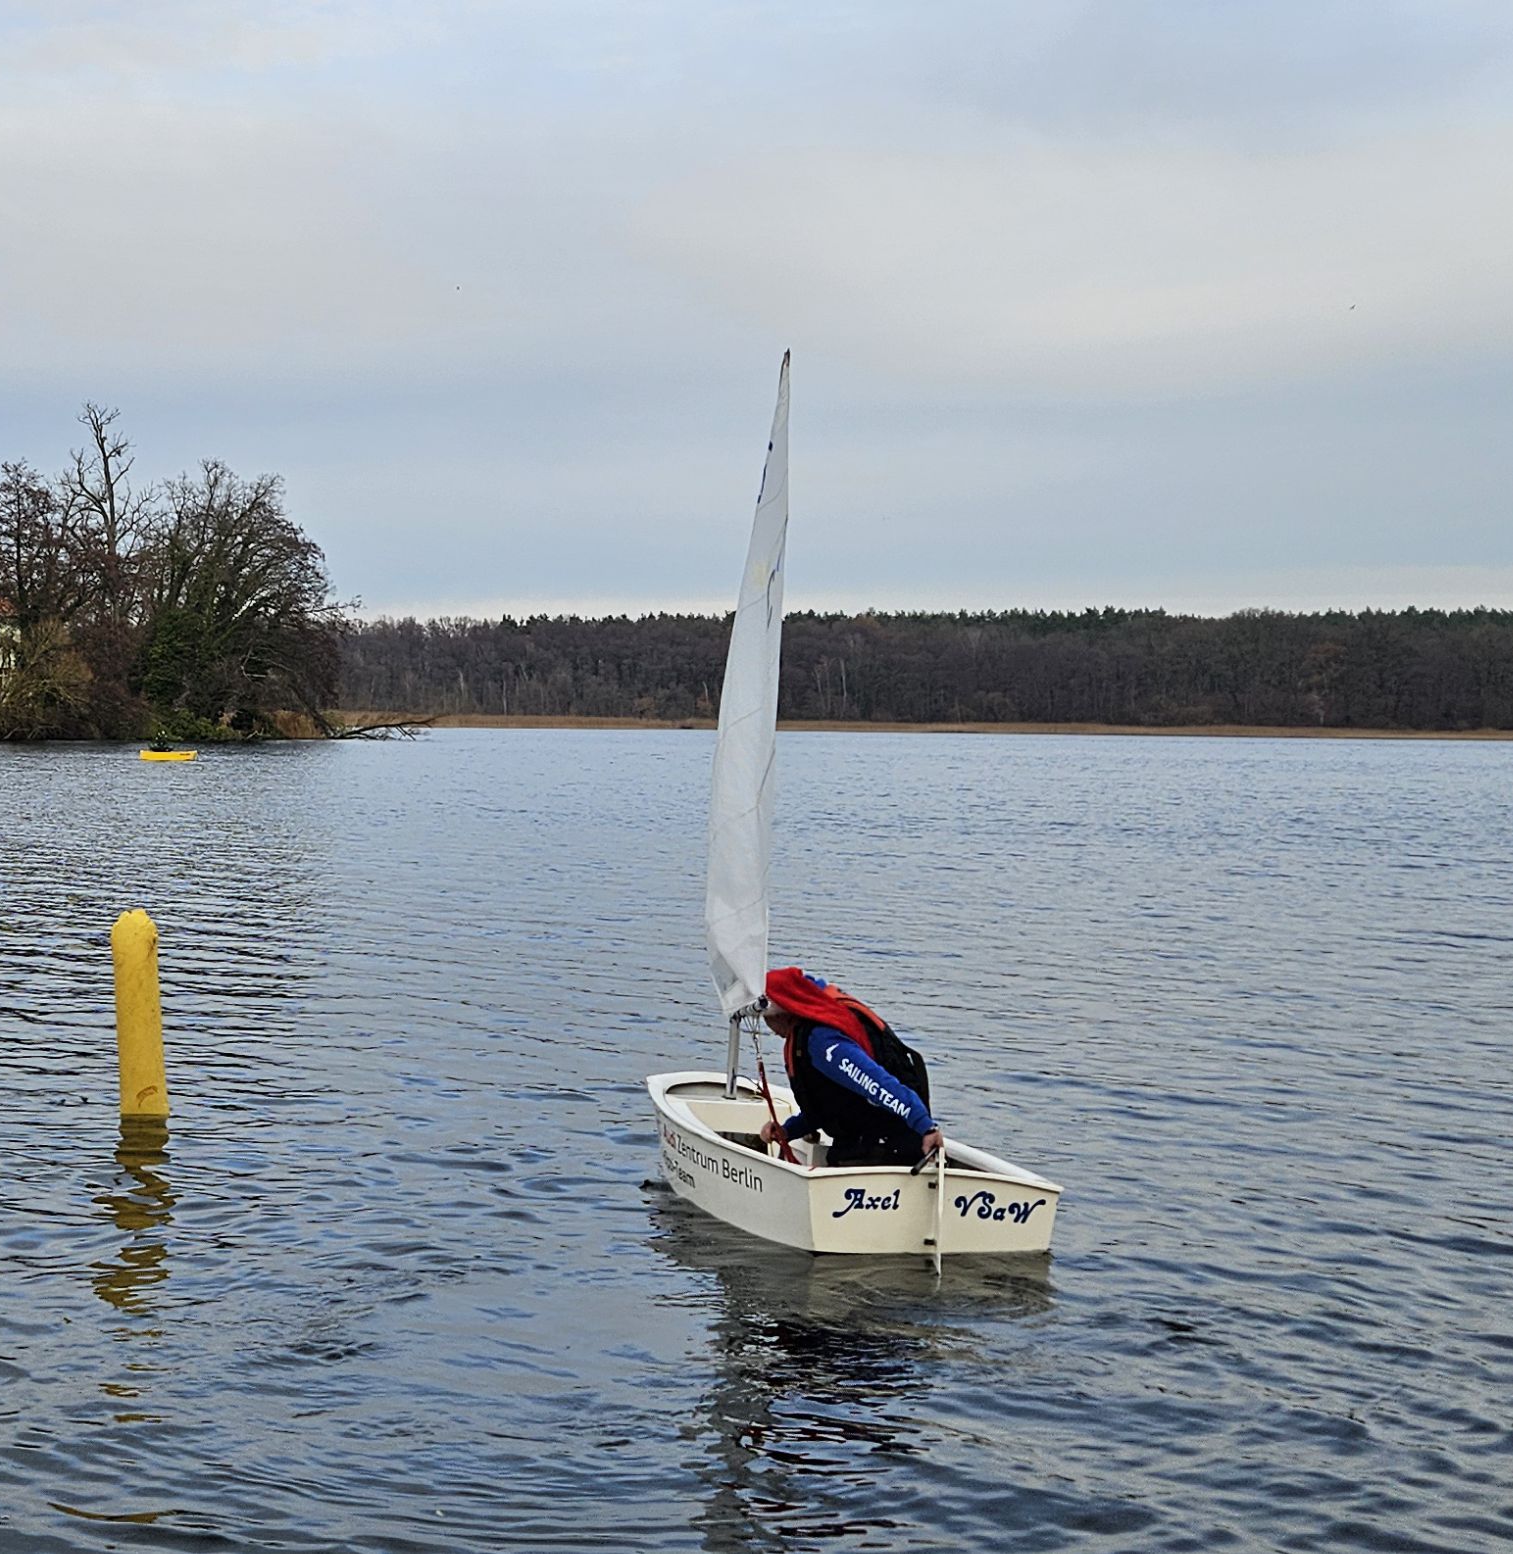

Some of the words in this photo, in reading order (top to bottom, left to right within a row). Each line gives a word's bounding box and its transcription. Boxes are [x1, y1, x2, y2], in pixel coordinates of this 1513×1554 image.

[838, 1058, 880, 1096] SAILING
[878, 1087, 912, 1119] TEAM
[677, 1134, 719, 1175] Zentrum
[721, 1158, 763, 1192] Berlin
[832, 1188, 901, 1219] Axel
[954, 1191, 1047, 1224] VSaW
